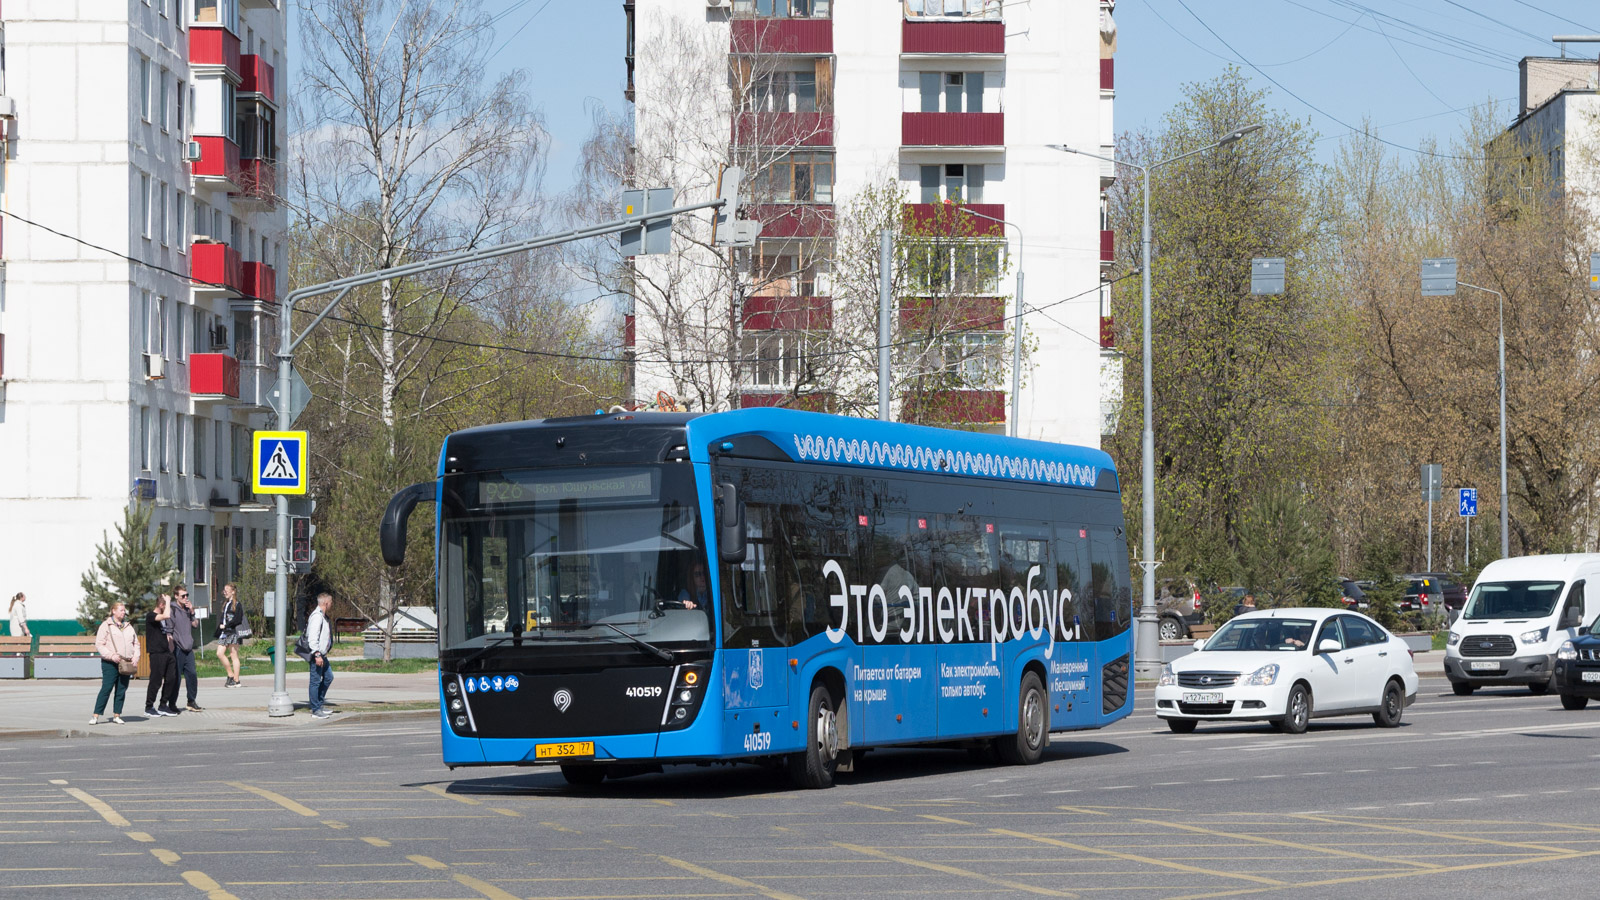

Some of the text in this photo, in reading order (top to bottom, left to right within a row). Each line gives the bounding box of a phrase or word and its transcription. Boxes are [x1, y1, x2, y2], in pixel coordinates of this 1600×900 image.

[486, 482, 523, 500] 926
[822, 559, 1080, 661] Это электробус.
[854, 663, 922, 683] Питается от батареи
[941, 661, 1001, 681] Как электромобиль,
[1050, 658, 1089, 674] Маневренный
[625, 686, 662, 698] 410519
[941, 680, 986, 700] только автобус
[1054, 676, 1086, 694] бесшумный
[854, 688, 887, 705] на крыше
[556, 744, 575, 755] 352
[580, 742, 590, 752] 77
[743, 731, 772, 752] 410519
